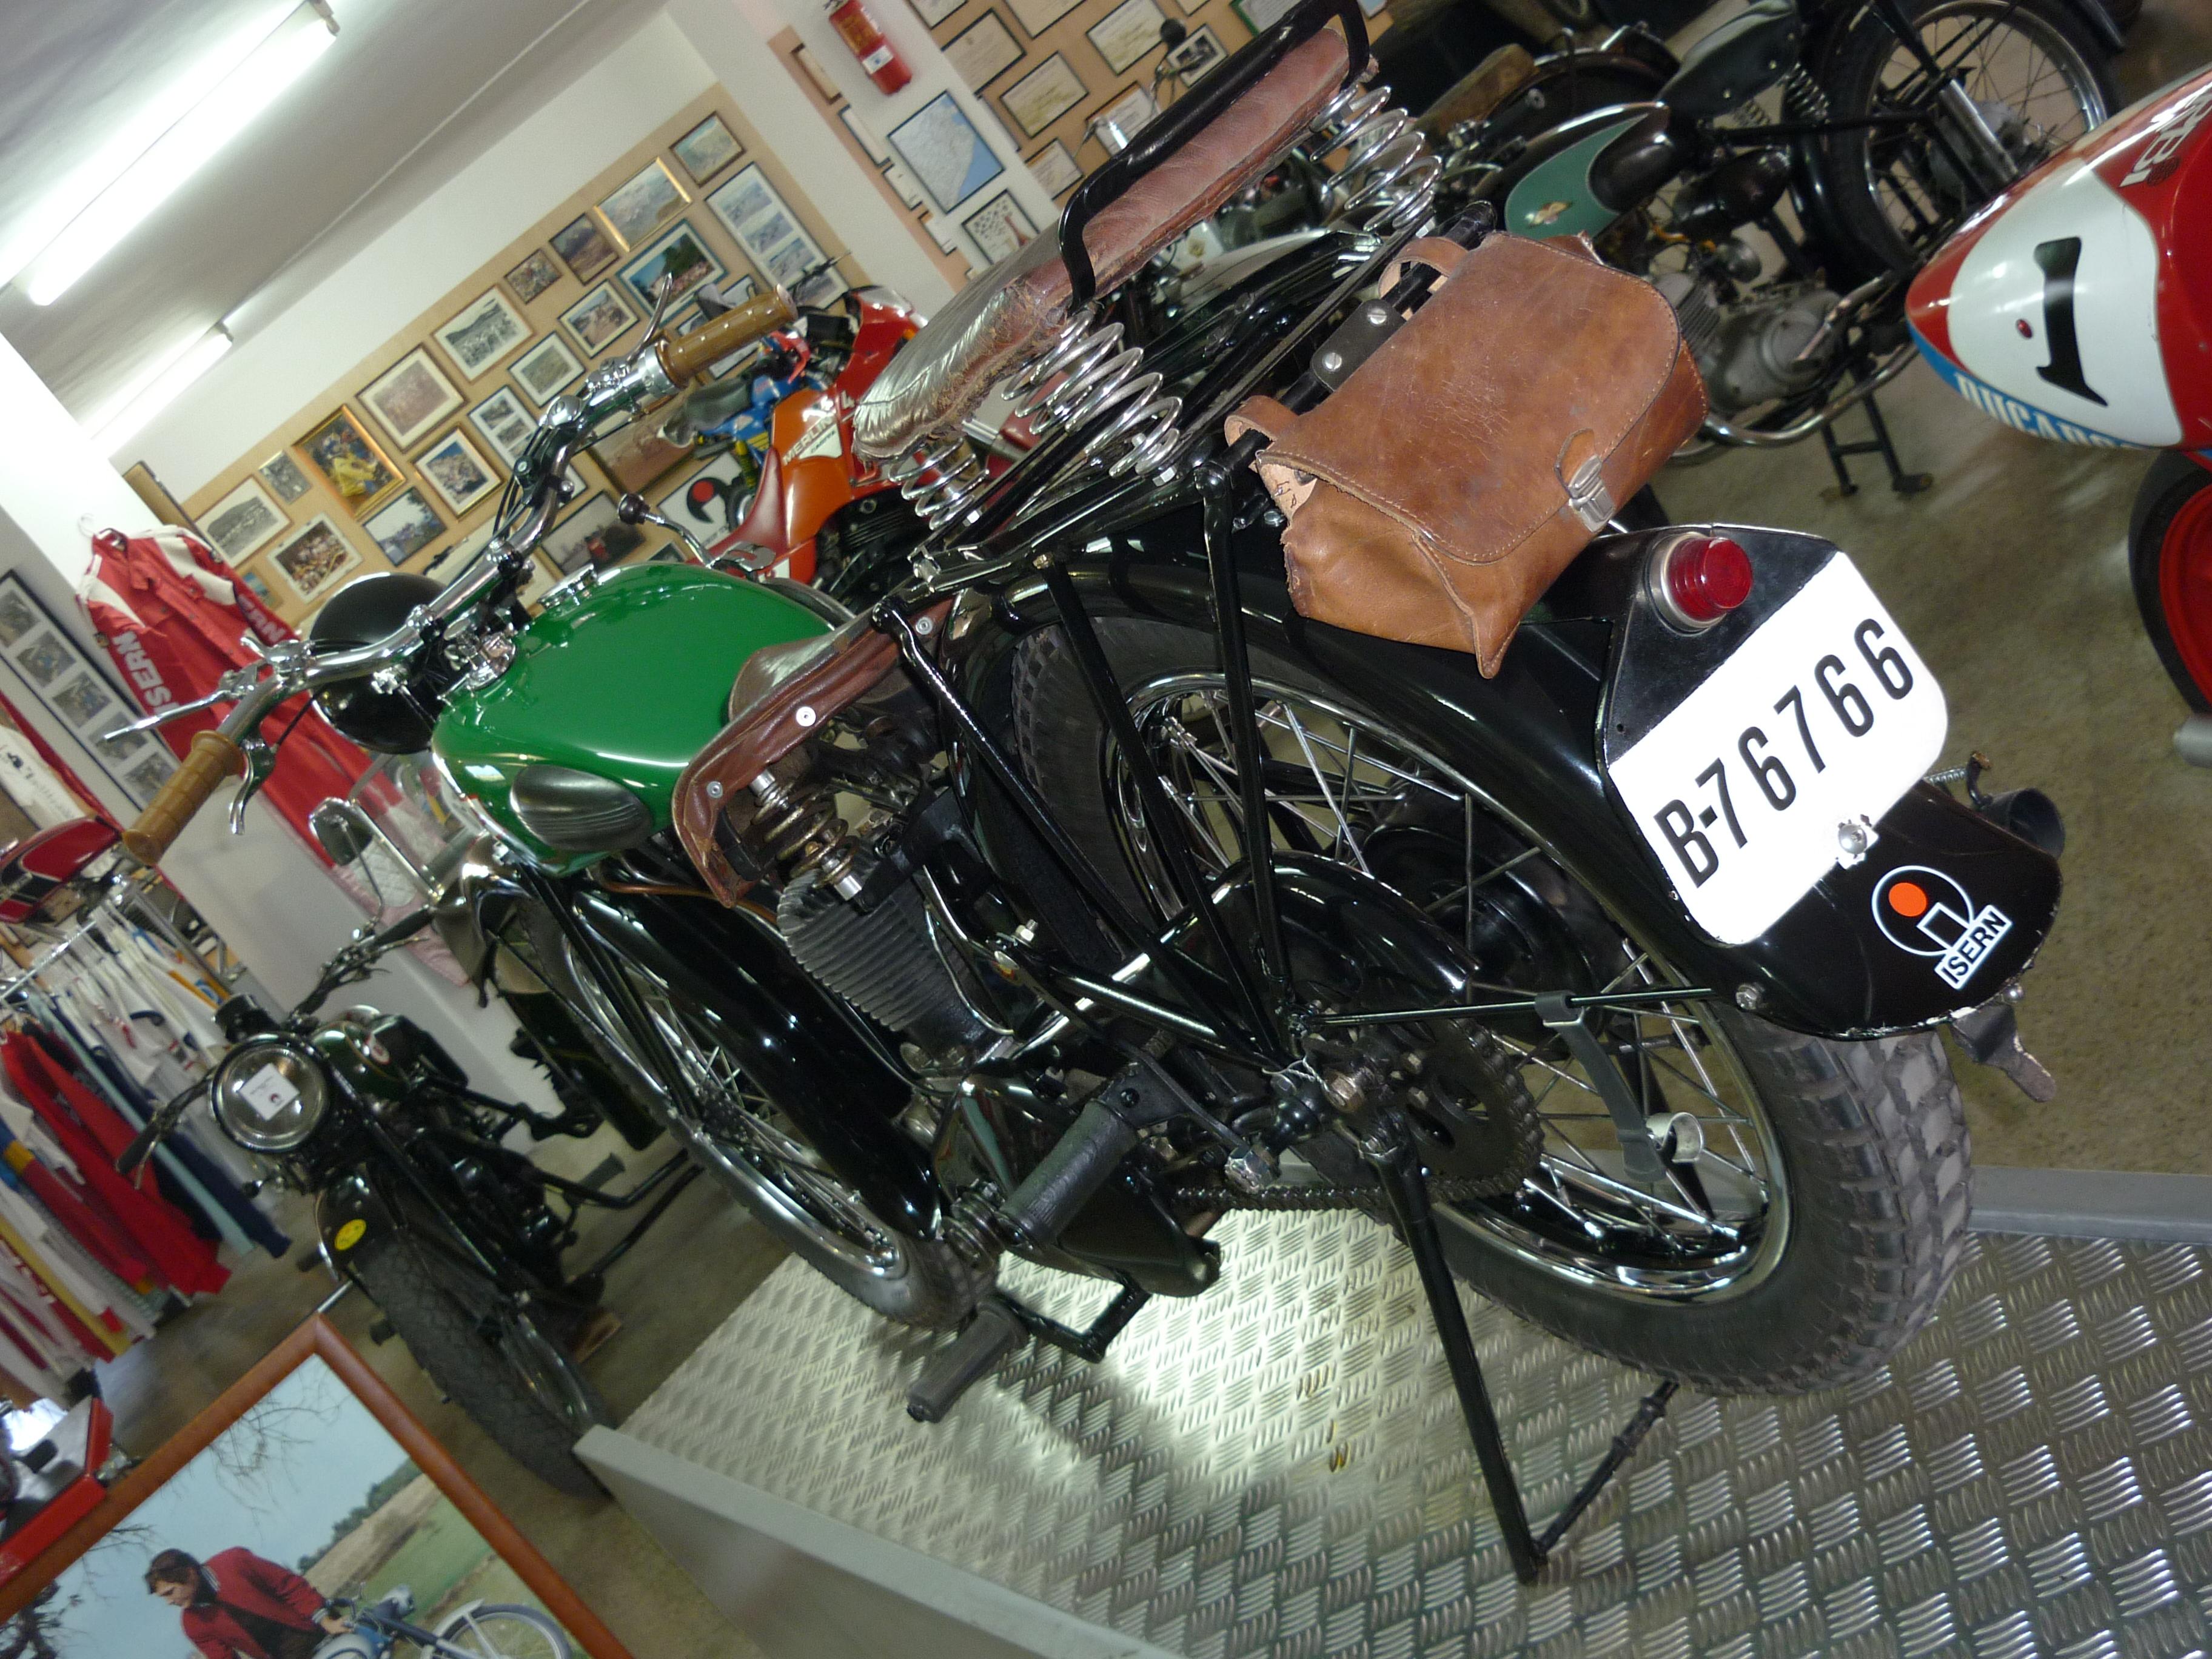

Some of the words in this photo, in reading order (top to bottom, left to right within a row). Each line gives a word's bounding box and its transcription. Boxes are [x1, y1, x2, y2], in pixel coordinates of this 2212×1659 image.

[2033, 236, 2108, 407] 1
[782, 415, 833, 466] MERLIN
[1954, 372, 2150, 451] DUCAD
[113, 630, 181, 716] ISERN
[1653, 618, 1914, 888] B-76766
[1941, 910, 2007, 984] ISERN
